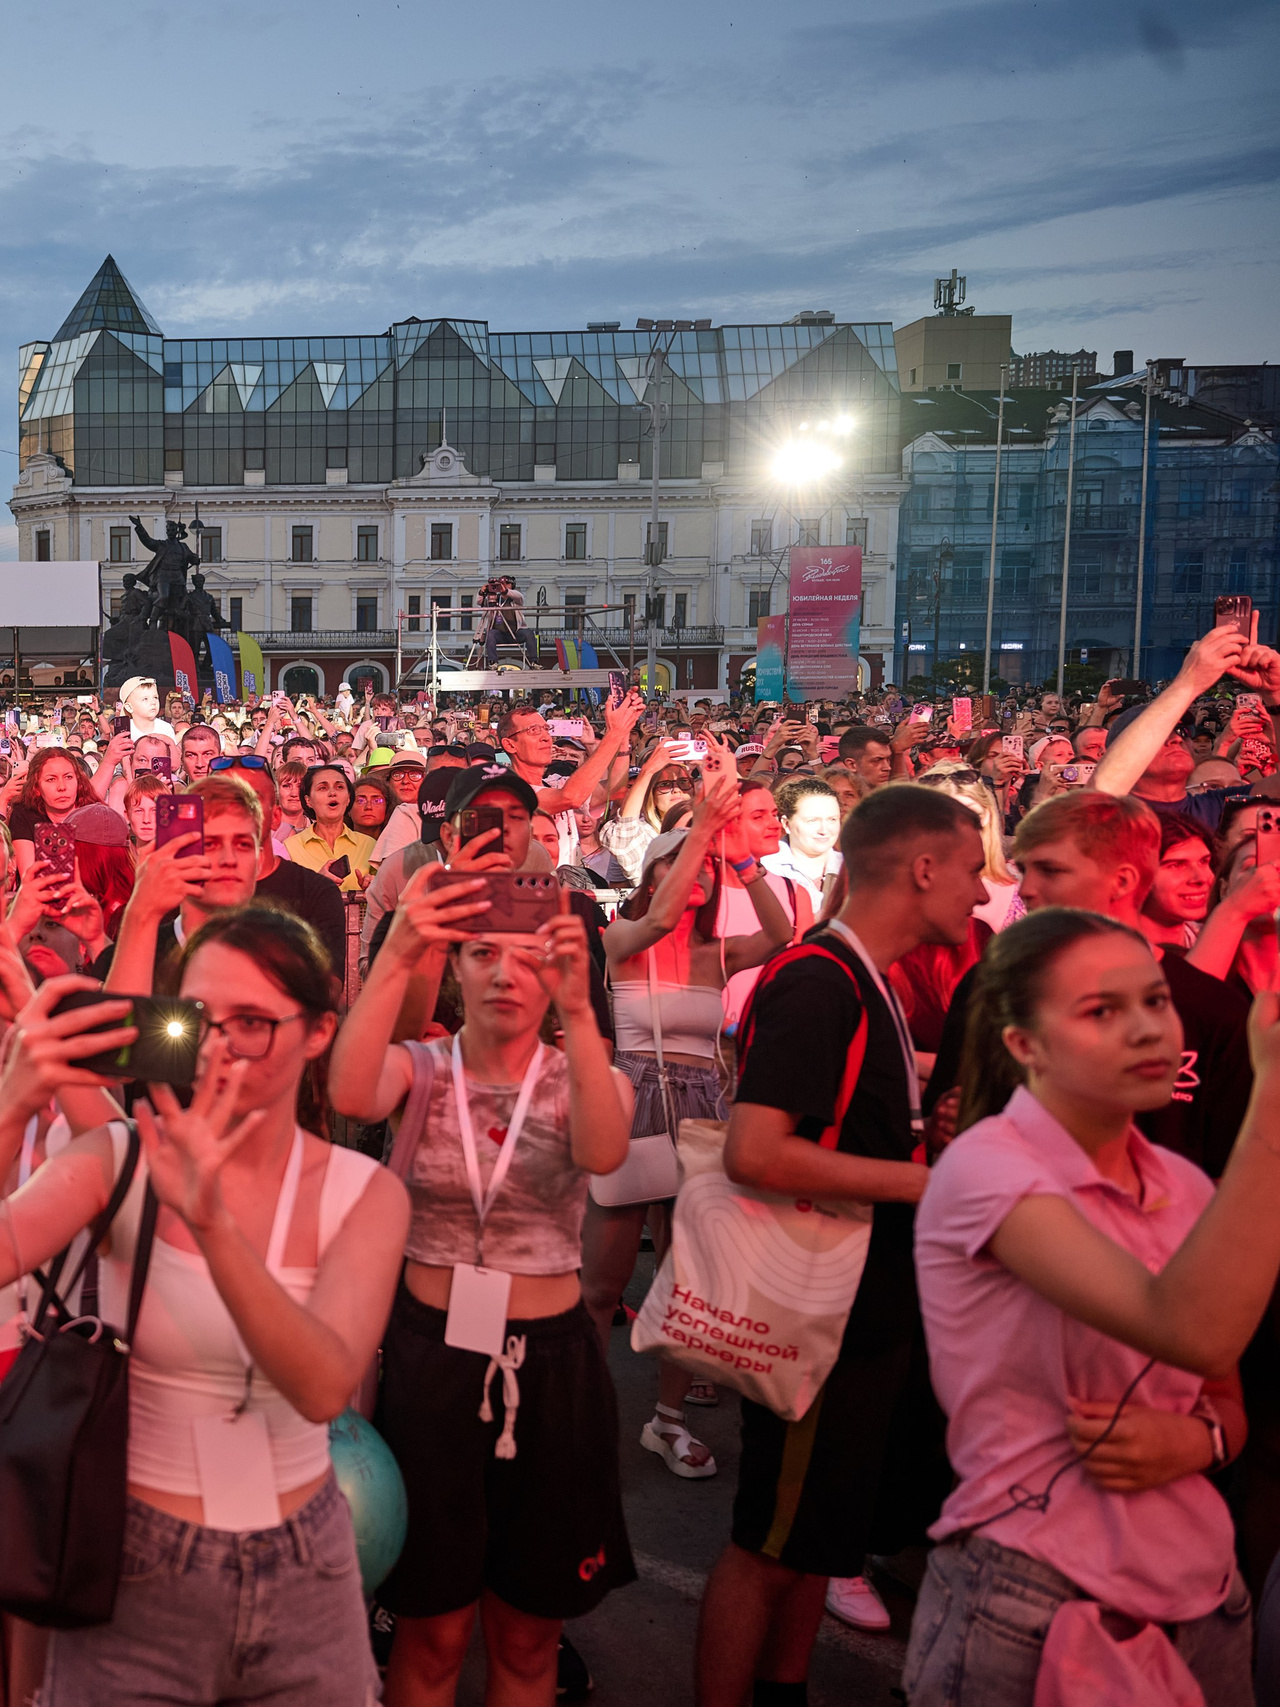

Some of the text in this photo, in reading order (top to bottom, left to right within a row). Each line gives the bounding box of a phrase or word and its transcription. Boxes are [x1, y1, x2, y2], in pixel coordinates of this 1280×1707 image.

[422, 800, 446, 815] Vladi
[664, 1304, 799, 1361] успешной
[672, 1283, 770, 1334] Начало
[661, 1322, 772, 1374] карьеры
